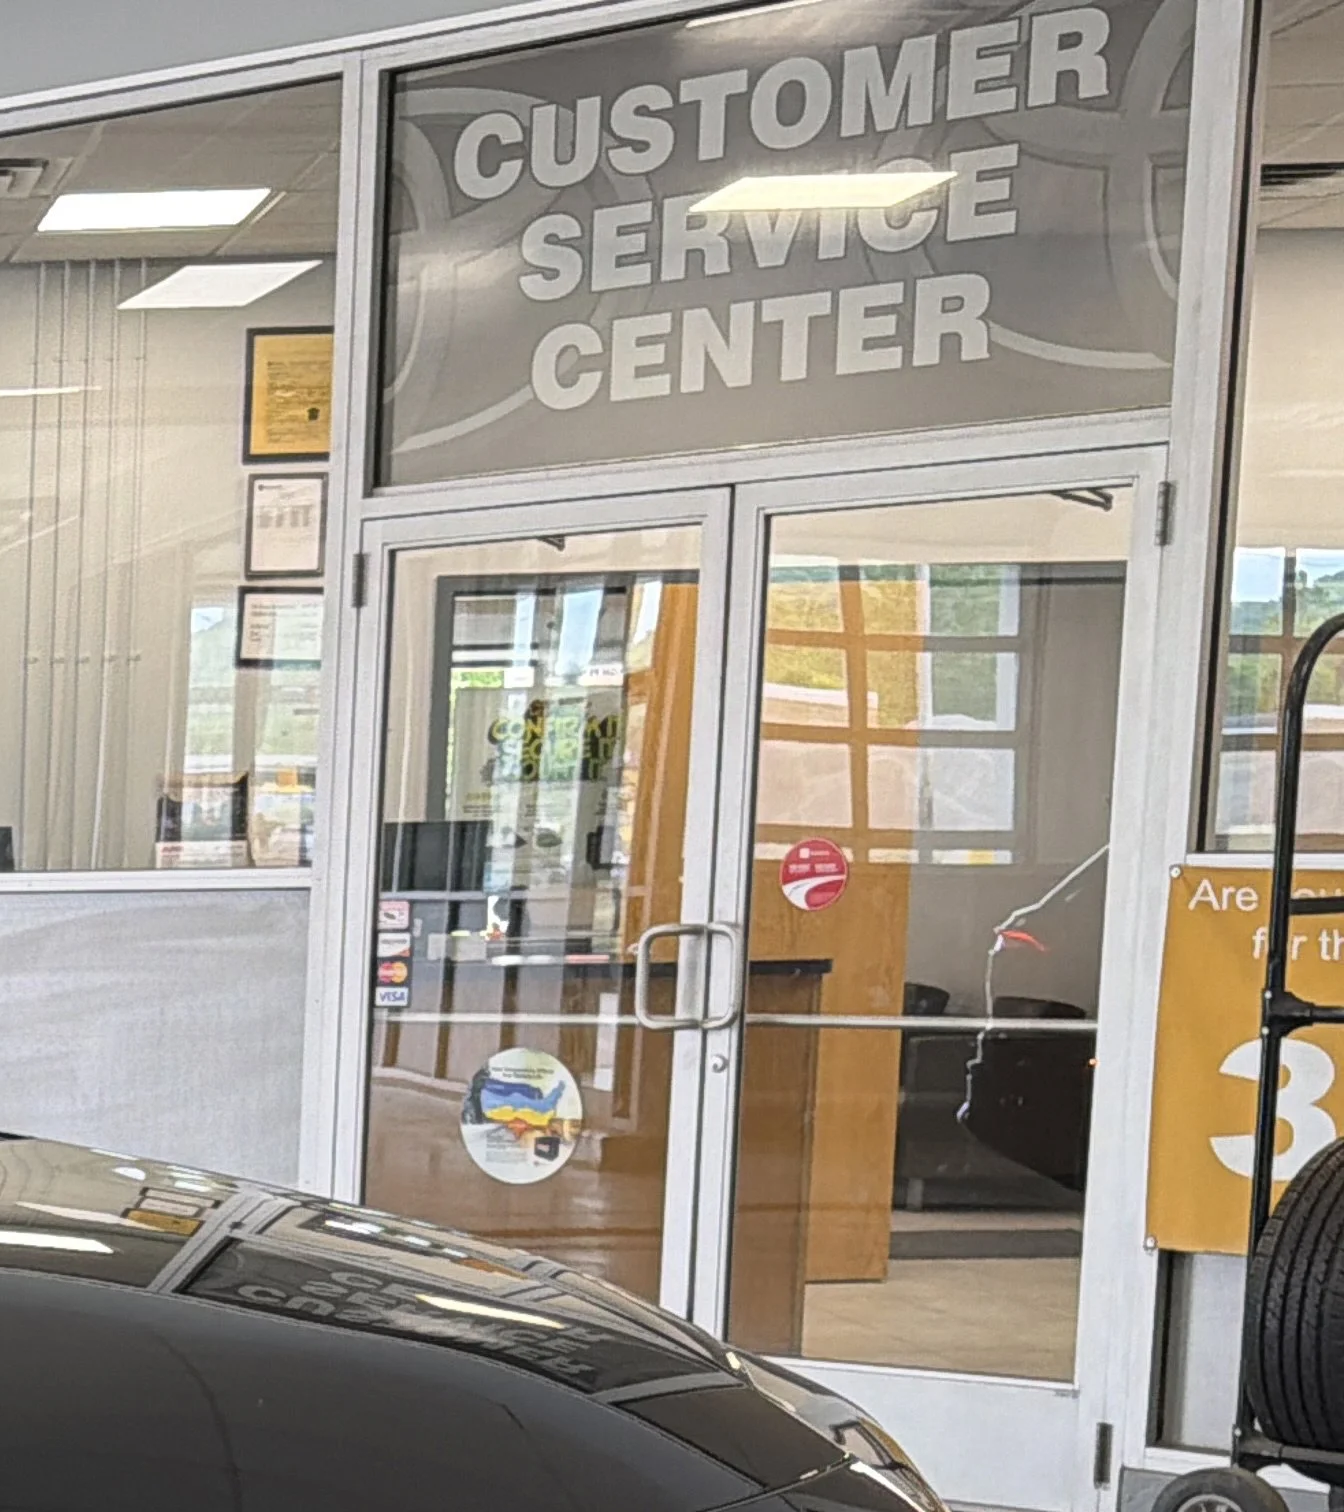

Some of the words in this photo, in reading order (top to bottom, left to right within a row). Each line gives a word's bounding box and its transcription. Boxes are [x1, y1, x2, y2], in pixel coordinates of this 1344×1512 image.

[454, 7, 1111, 200] CUSTOMER
[518, 142, 1018, 301] SERVICE
[531, 273, 990, 410] CENTER
[1188, 878, 1260, 911] Are
[1252, 928, 1308, 961] fr
[1209, 1036, 1336, 1182] 3
